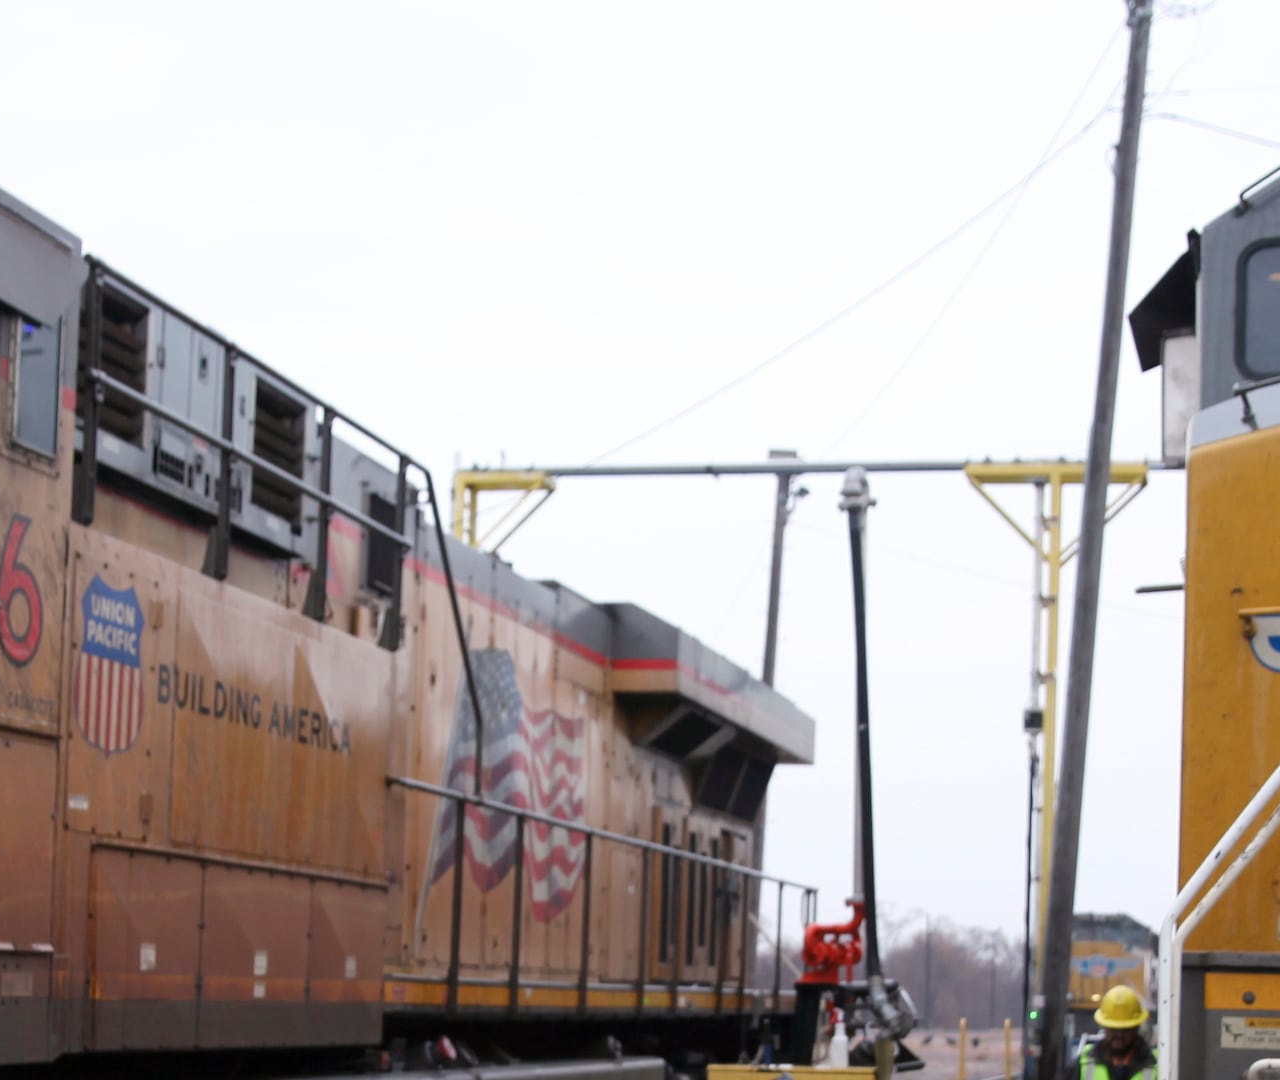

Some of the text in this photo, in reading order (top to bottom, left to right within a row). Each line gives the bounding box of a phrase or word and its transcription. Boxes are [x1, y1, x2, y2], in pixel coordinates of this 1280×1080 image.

[91, 592, 136, 629] UNION
[87, 618, 138, 656] PACIFIC
[157, 662, 352, 756] BUILDING AMERICA
